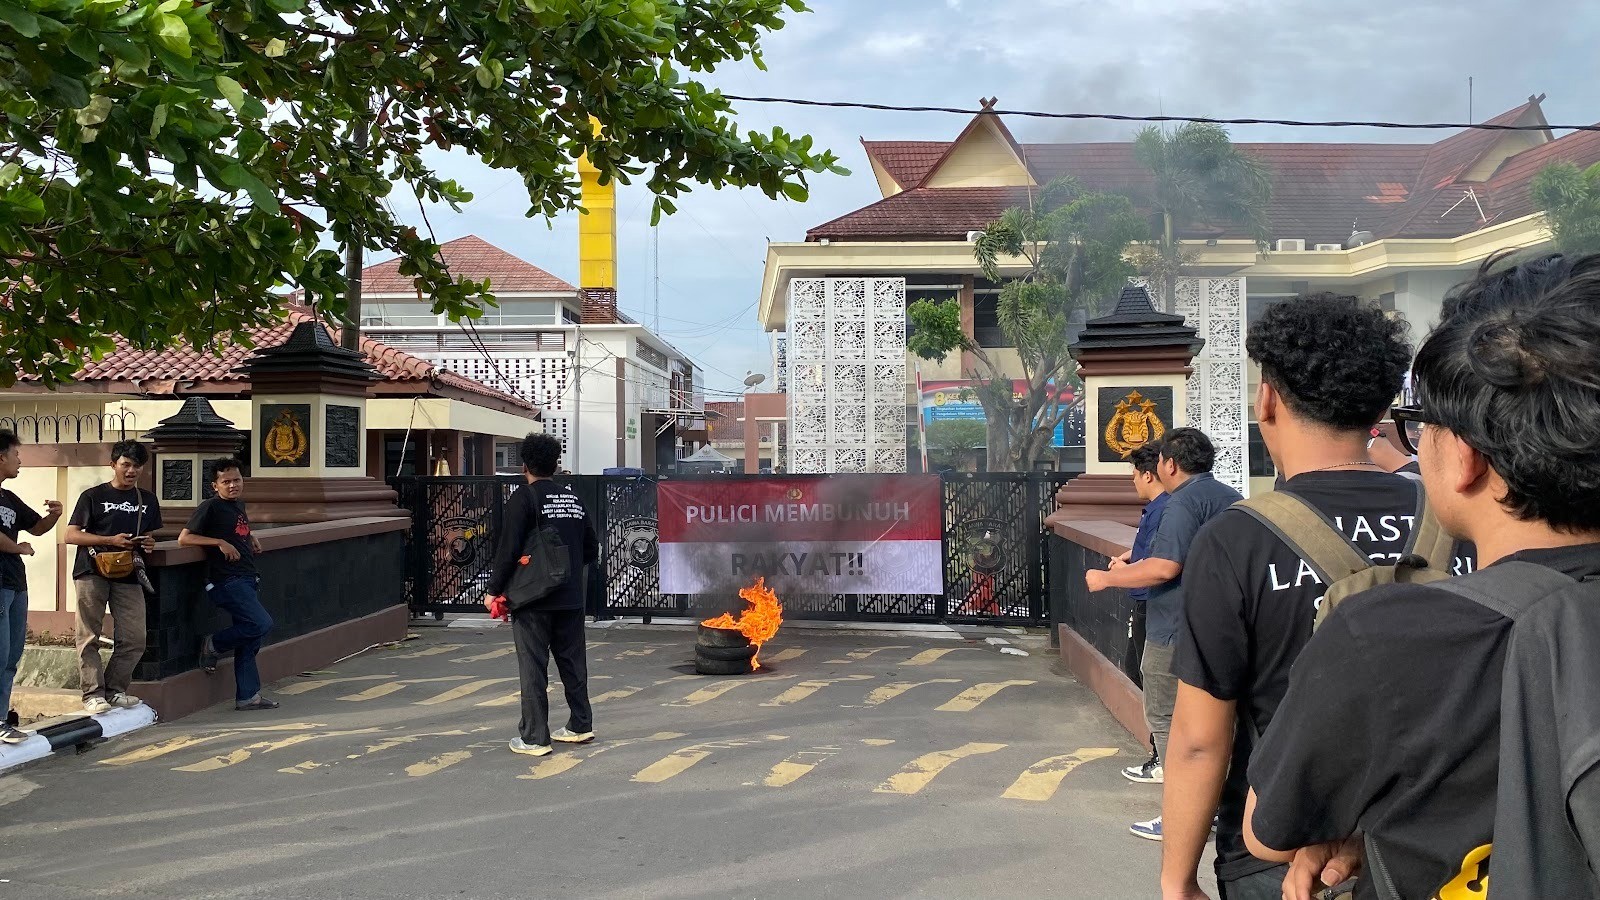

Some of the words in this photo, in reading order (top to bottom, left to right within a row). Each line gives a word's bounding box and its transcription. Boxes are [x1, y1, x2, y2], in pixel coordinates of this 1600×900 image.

[934, 391, 945, 406] 8
[686, 504, 757, 523] PULICI
[765, 503, 910, 522] MEMBUNUH
[626, 520, 640, 528] JAWA
[732, 552, 864, 576] RAKYAT!!
